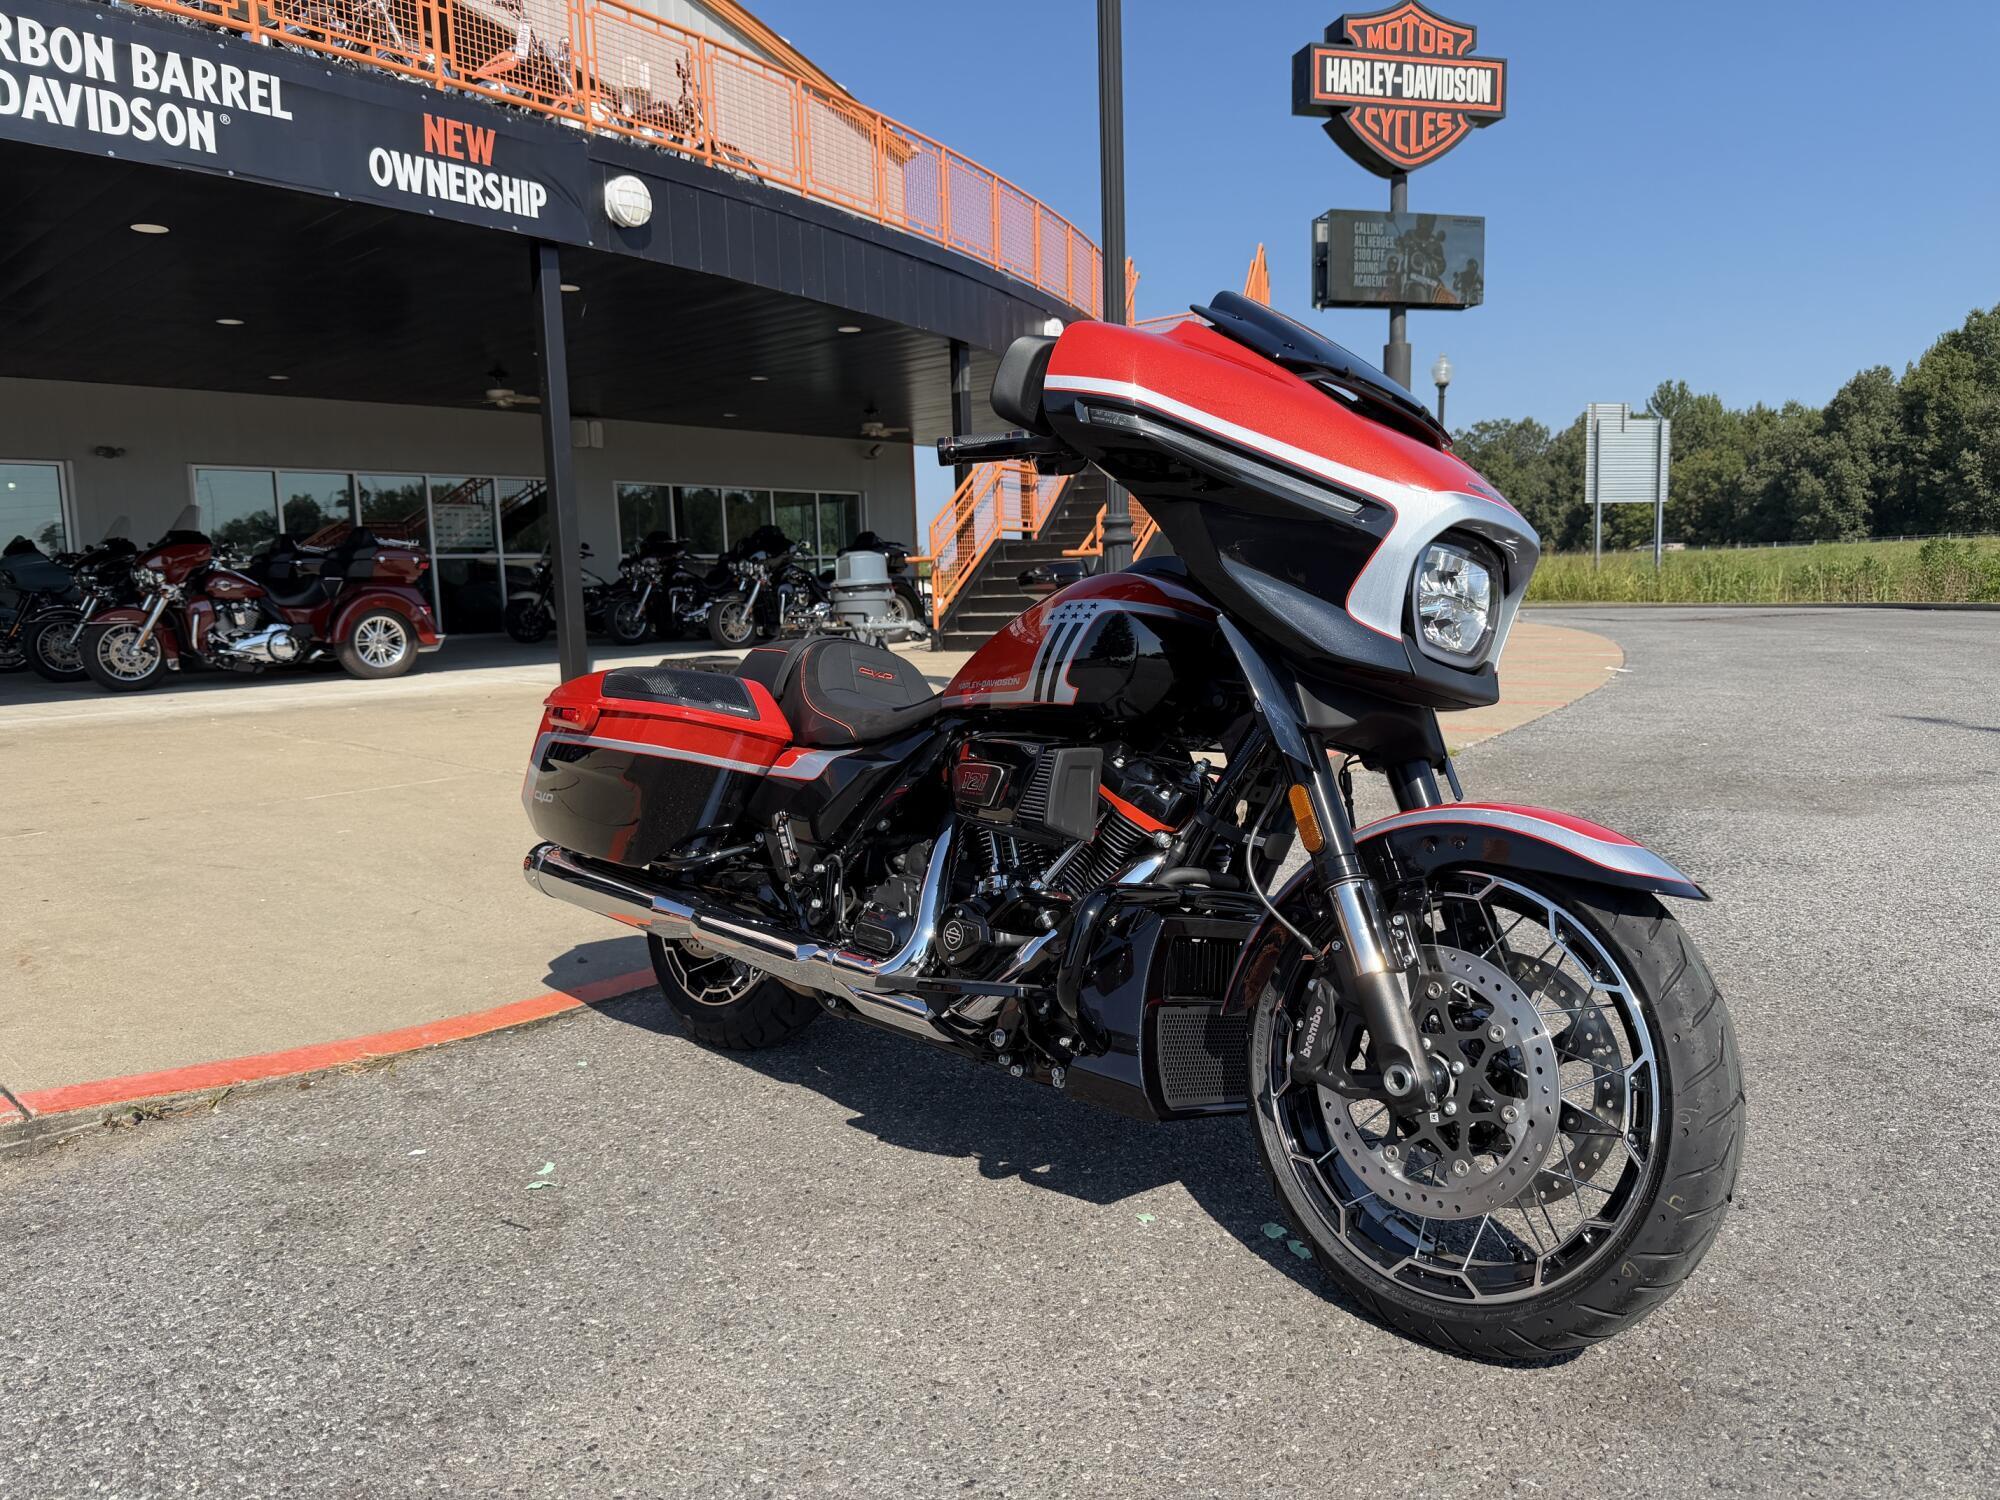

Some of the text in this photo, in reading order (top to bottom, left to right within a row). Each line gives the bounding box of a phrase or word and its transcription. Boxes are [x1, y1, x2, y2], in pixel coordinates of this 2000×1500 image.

[1366, 13, 1454, 56] MOTOR
[130, 42, 293, 121] BARREL
[1325, 57, 1492, 104] HARLEY-DAVIDSON
[423, 112, 497, 167] NEW
[1365, 107, 1453, 155] CYCLES
[368, 146, 547, 219] OWNERSHIP
[1353, 221, 1384, 235] CALLING
[1353, 235, 1366, 248] ALL
[1353, 248, 1386, 261] $100 OFF
[1353, 261, 1379, 273] RIDING
[961, 771, 989, 791] 121
[1300, 1005, 1324, 1058] brembo
